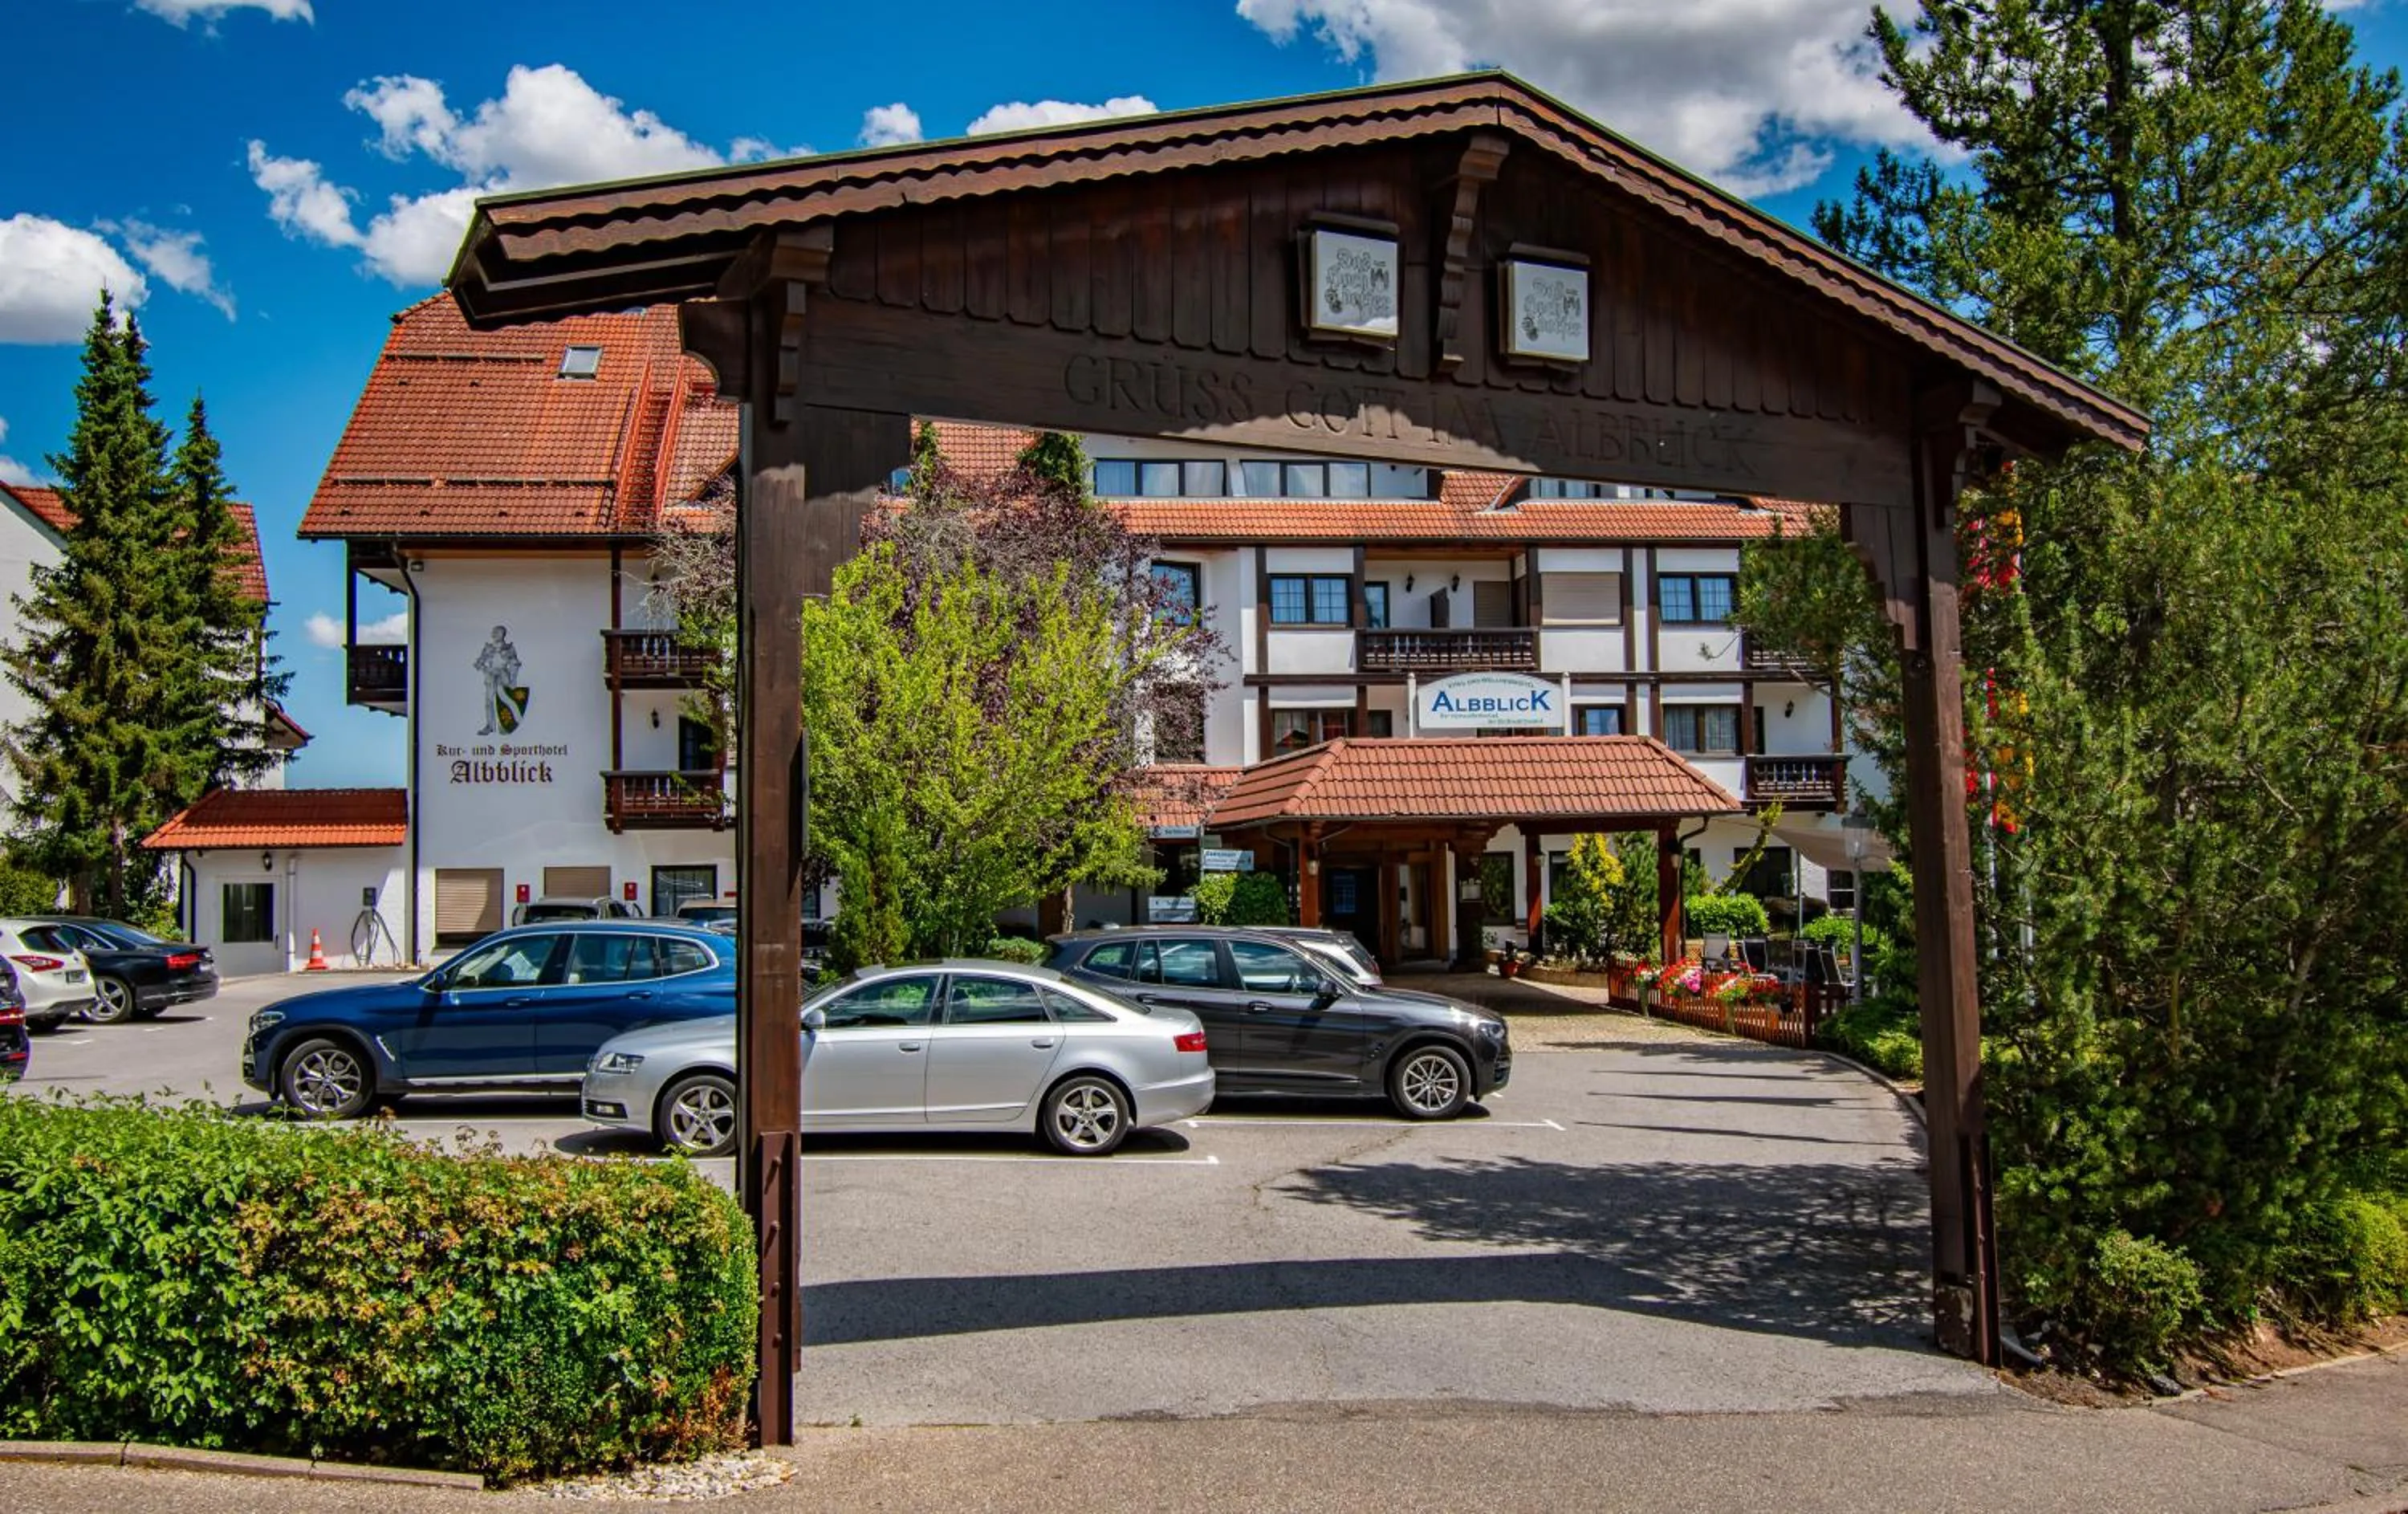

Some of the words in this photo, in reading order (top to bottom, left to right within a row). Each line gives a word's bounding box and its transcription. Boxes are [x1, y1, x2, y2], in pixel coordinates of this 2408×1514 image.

[1284, 380, 1406, 439] GOTT
[1425, 391, 1508, 450] IM
[436, 743, 466, 757] Kur-
[472, 744, 495, 756] und
[499, 743, 568, 758] Sporthotel
[450, 759, 553, 784] Albblick
